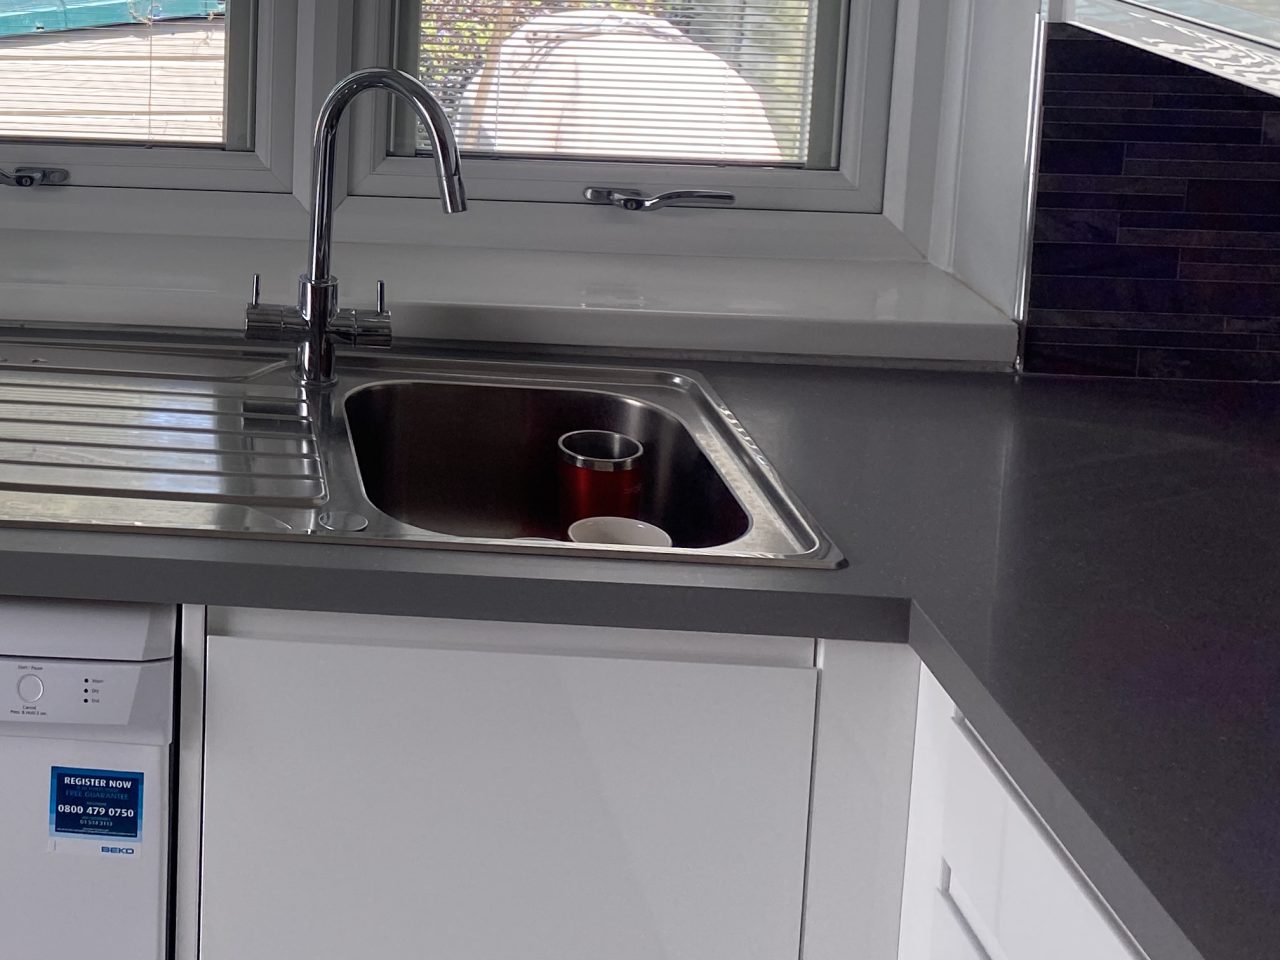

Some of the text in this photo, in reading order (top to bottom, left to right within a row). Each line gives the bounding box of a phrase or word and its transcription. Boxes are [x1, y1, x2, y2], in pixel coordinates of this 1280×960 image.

[64, 776, 107, 788] REGISTER
[109, 780, 132, 789] NOW
[58, 804, 135, 818] 0800 479 0750
[101, 846, 136, 855] BEKO
